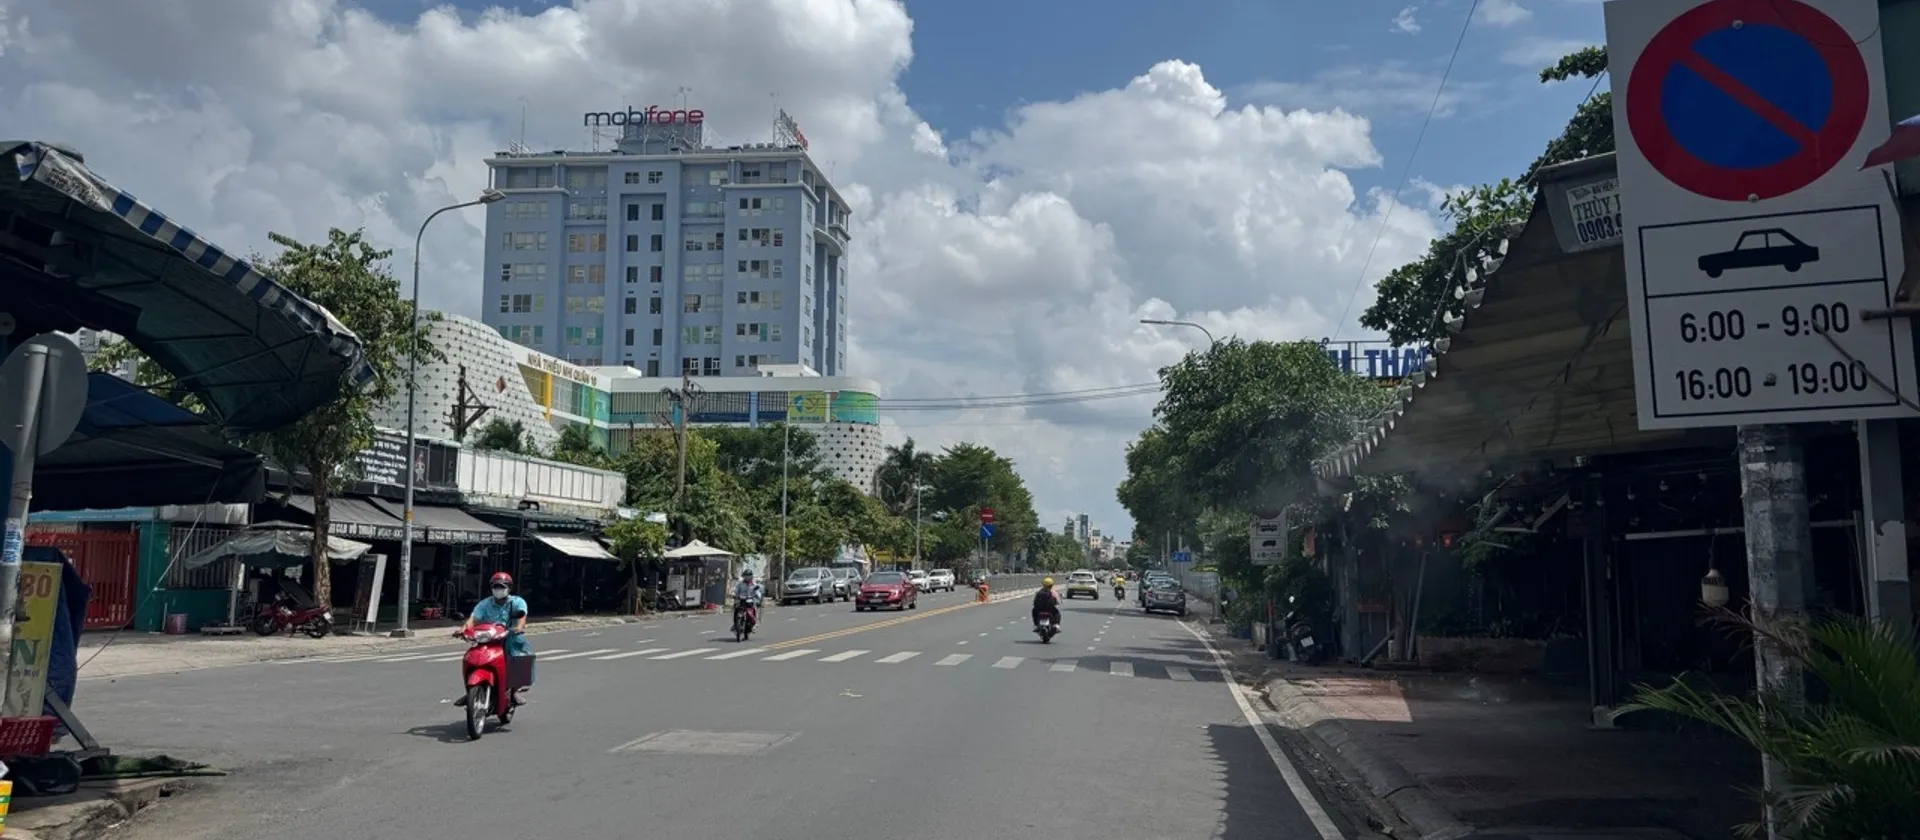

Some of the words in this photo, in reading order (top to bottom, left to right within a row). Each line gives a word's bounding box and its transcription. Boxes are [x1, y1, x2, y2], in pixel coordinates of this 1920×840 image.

[584, 105, 704, 126] mobifone
[1573, 195, 1611, 221] THÙY
[1680, 309, 1745, 343] 6:00
[1782, 302, 1849, 336] 9:00
[1675, 366, 1752, 401] 16:00
[1788, 360, 1867, 395] 19:00
